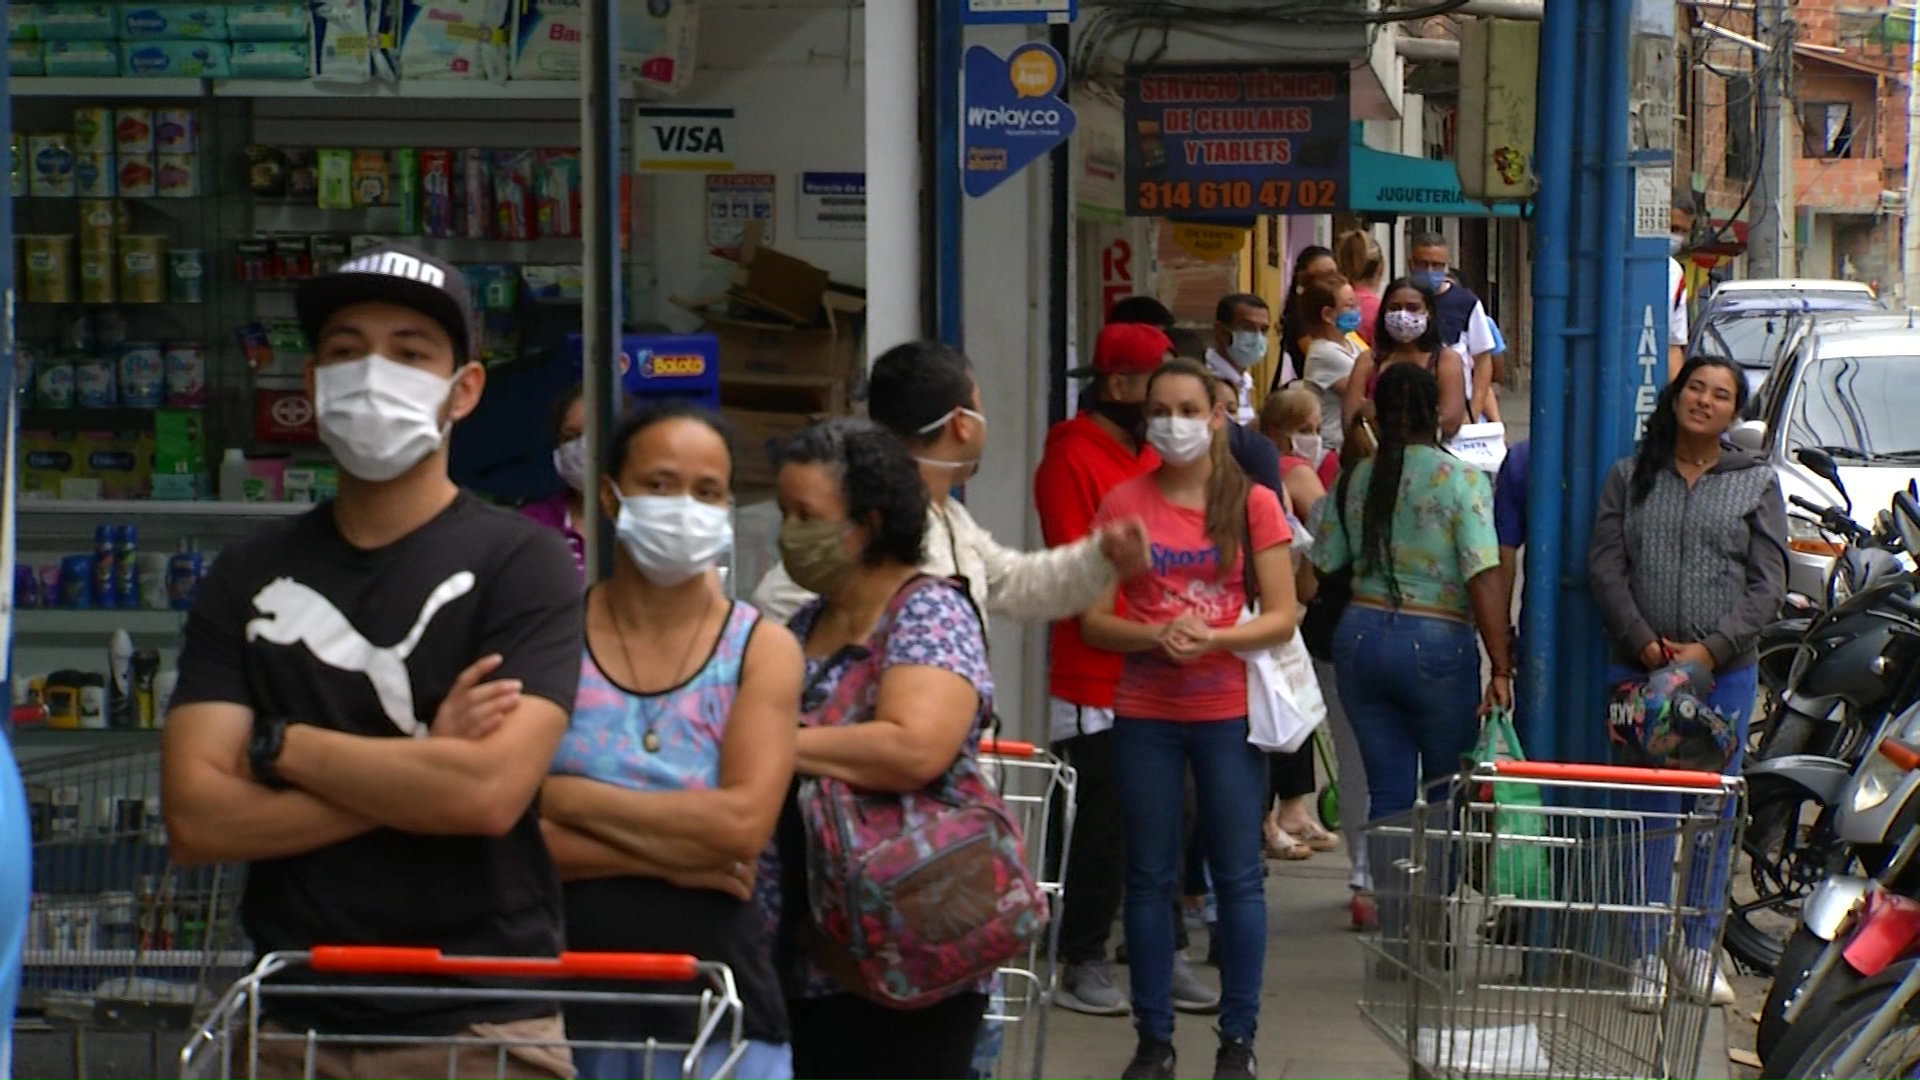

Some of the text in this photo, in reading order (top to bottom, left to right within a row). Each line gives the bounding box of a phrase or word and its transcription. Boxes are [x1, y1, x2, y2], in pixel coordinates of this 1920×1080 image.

[1139, 69, 1336, 102] SERVICIO TÉCNICO
[1163, 106, 1311, 134] DE CELULARES
[652, 125, 725, 153] VISA
[1184, 138, 1291, 165] Y TABLETS
[1138, 179, 1336, 210] 314 610 47 02
[1376, 186, 1465, 205] JUGUETERÍA
